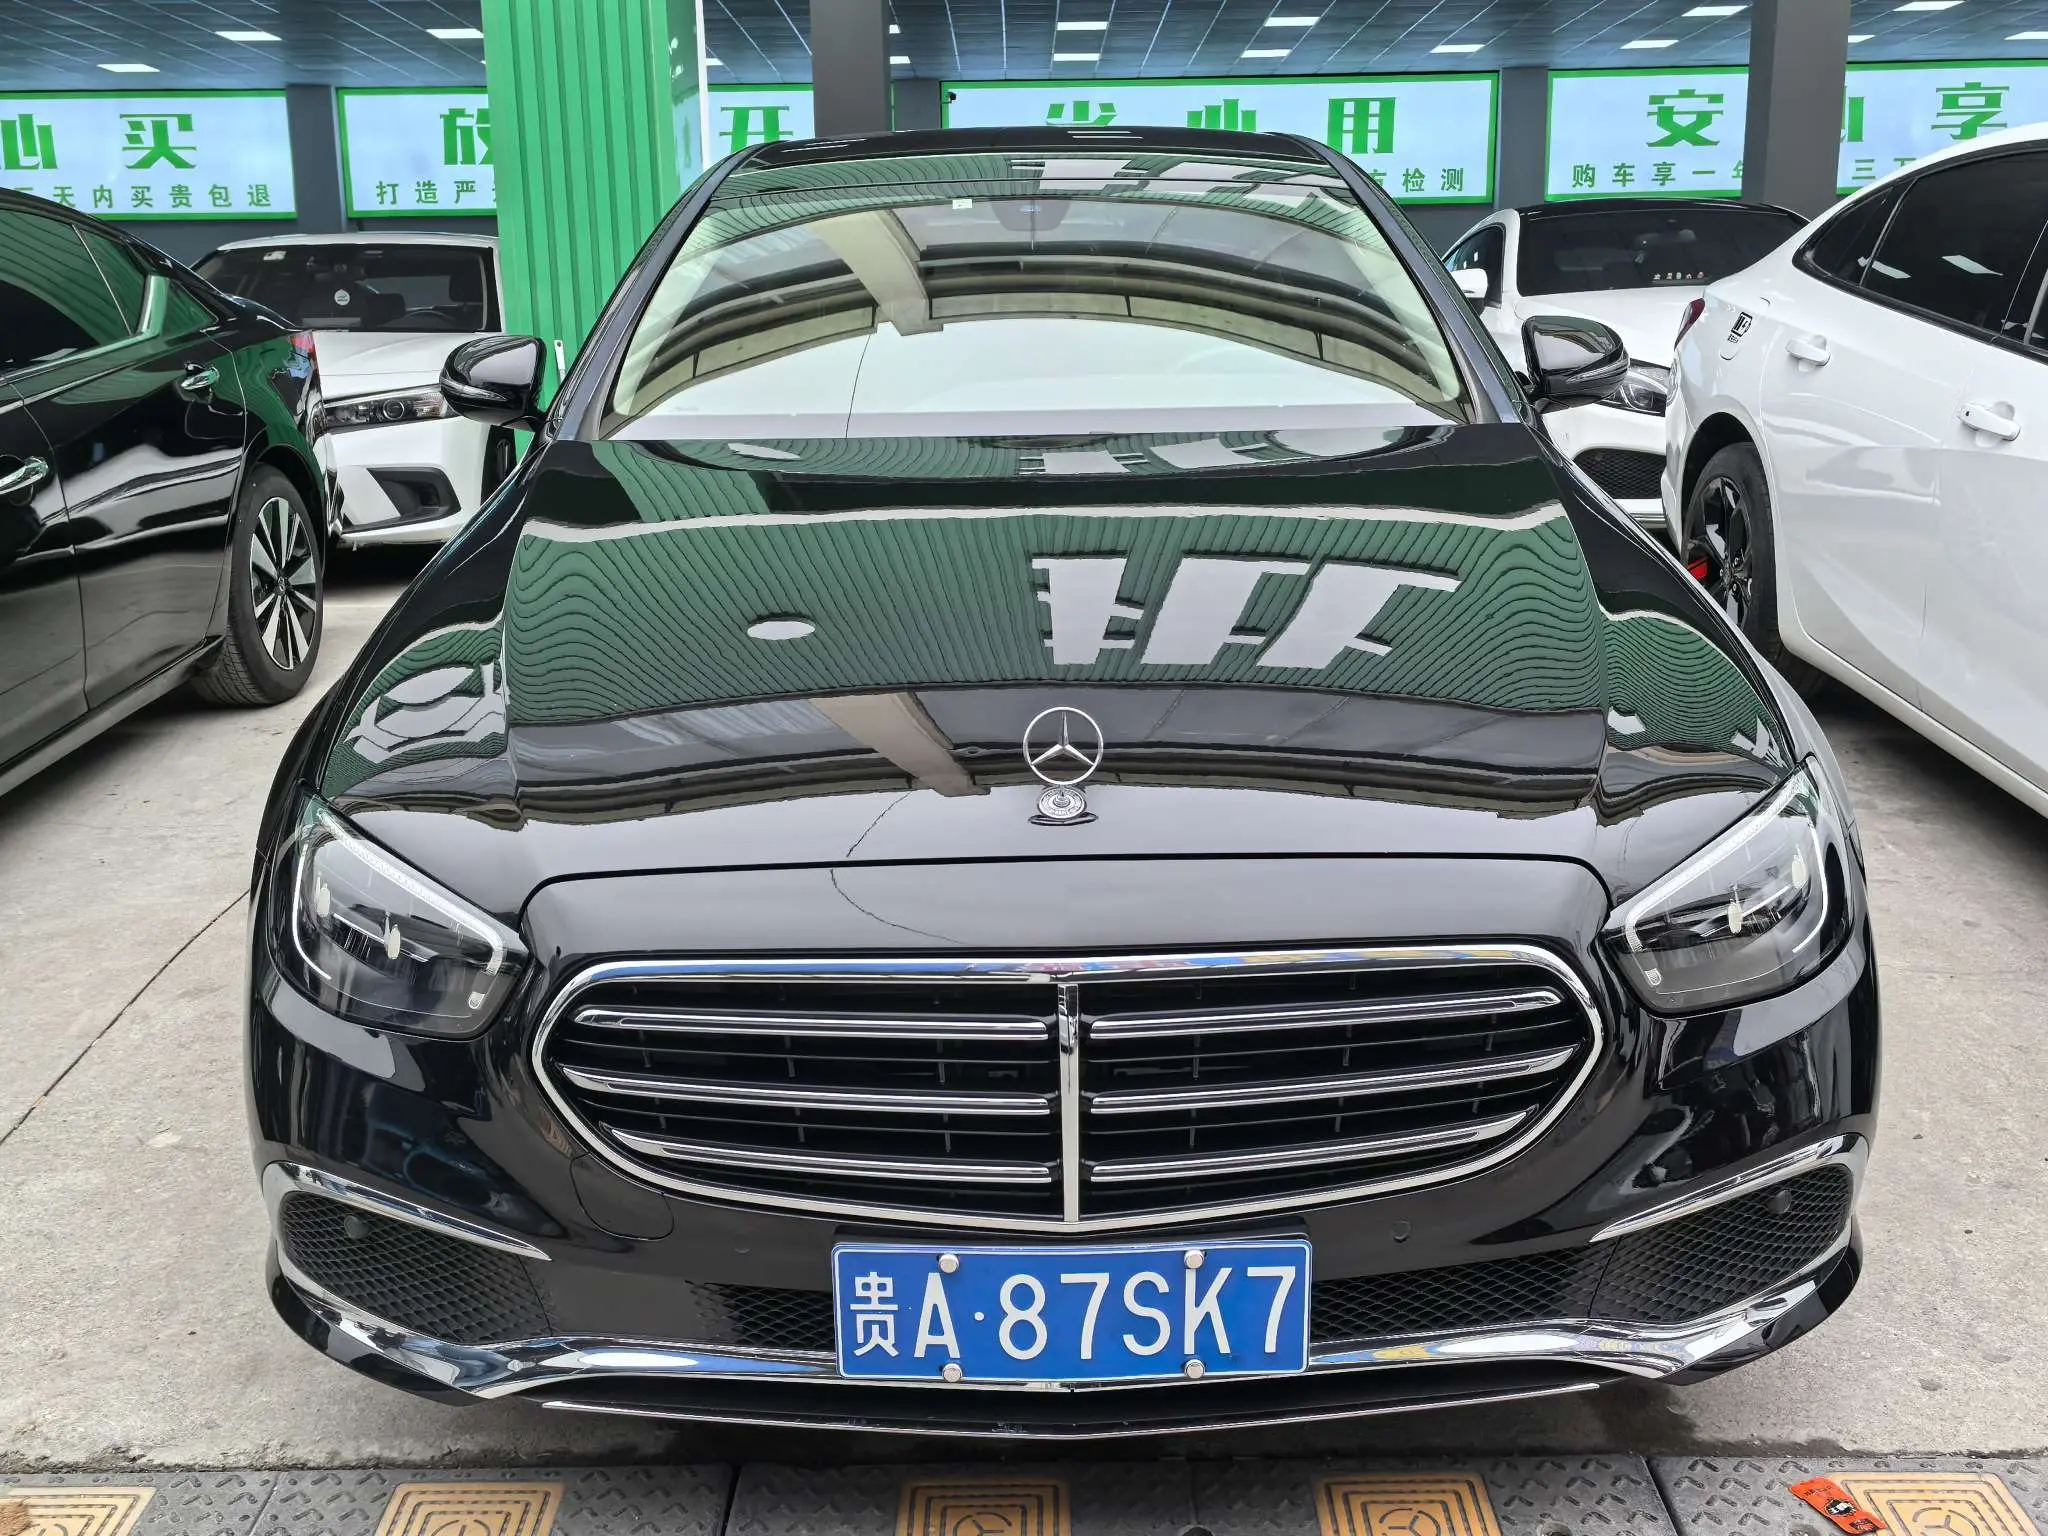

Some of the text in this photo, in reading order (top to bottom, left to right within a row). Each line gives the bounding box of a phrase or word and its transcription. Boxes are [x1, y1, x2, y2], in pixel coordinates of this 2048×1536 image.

[1646, 89, 1725, 147] 安
[13, 183, 272, 209] 天内买贵包退
[376, 180, 497, 205] 打造严
